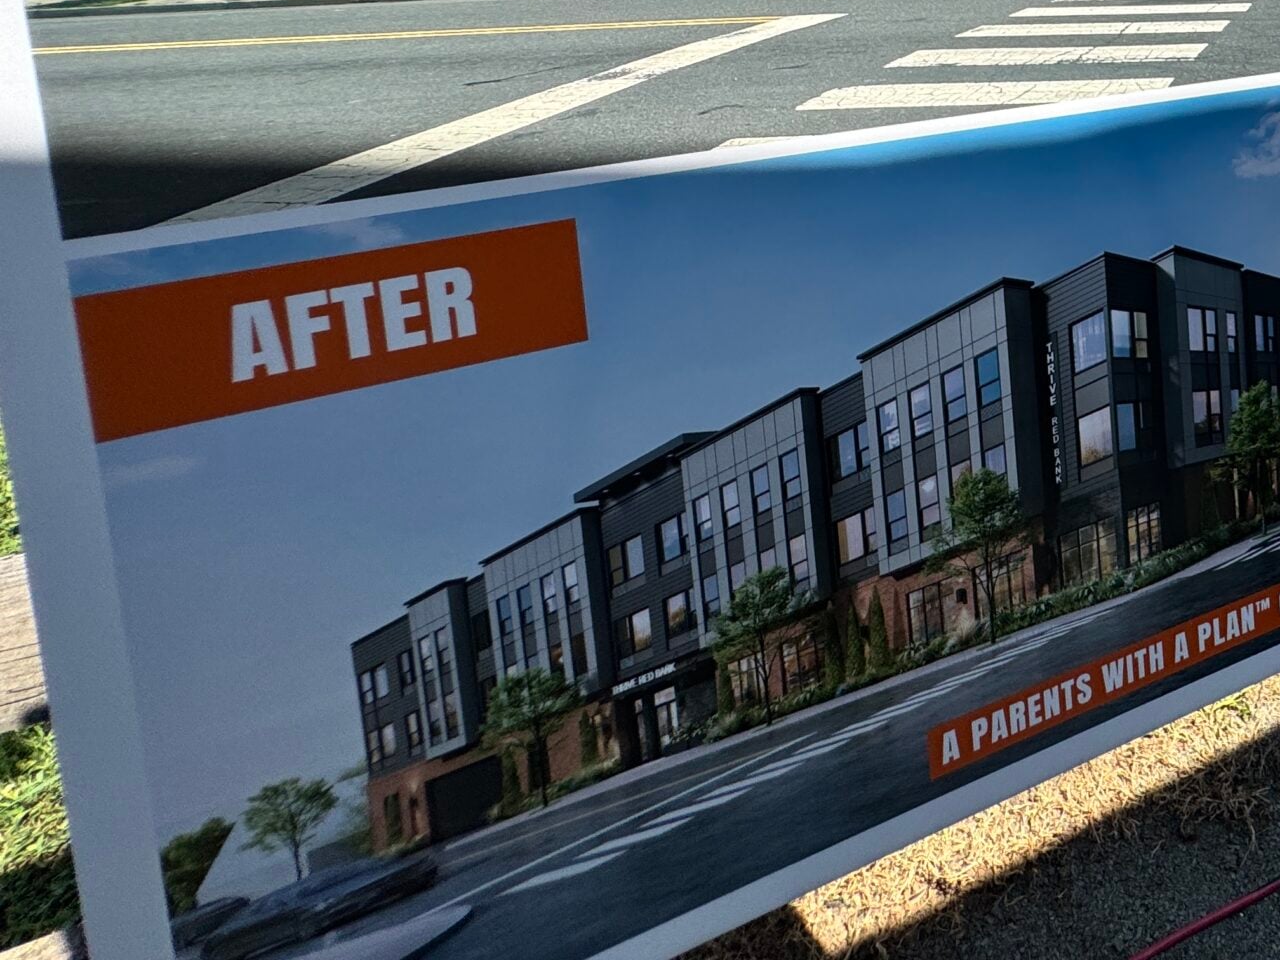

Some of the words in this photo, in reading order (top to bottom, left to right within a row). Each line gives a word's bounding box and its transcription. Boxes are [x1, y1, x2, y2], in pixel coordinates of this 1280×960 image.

[231, 266, 477, 383] AFTER
[1046, 342, 1057, 407] THRIVE
[1051, 416, 1059, 444] RED
[1054, 448, 1063, 485] BANK
[942, 729, 961, 765] A
[971, 672, 1093, 752] PARENTS
[1102, 640, 1164, 693] WITH
[1174, 631, 1190, 664] A
